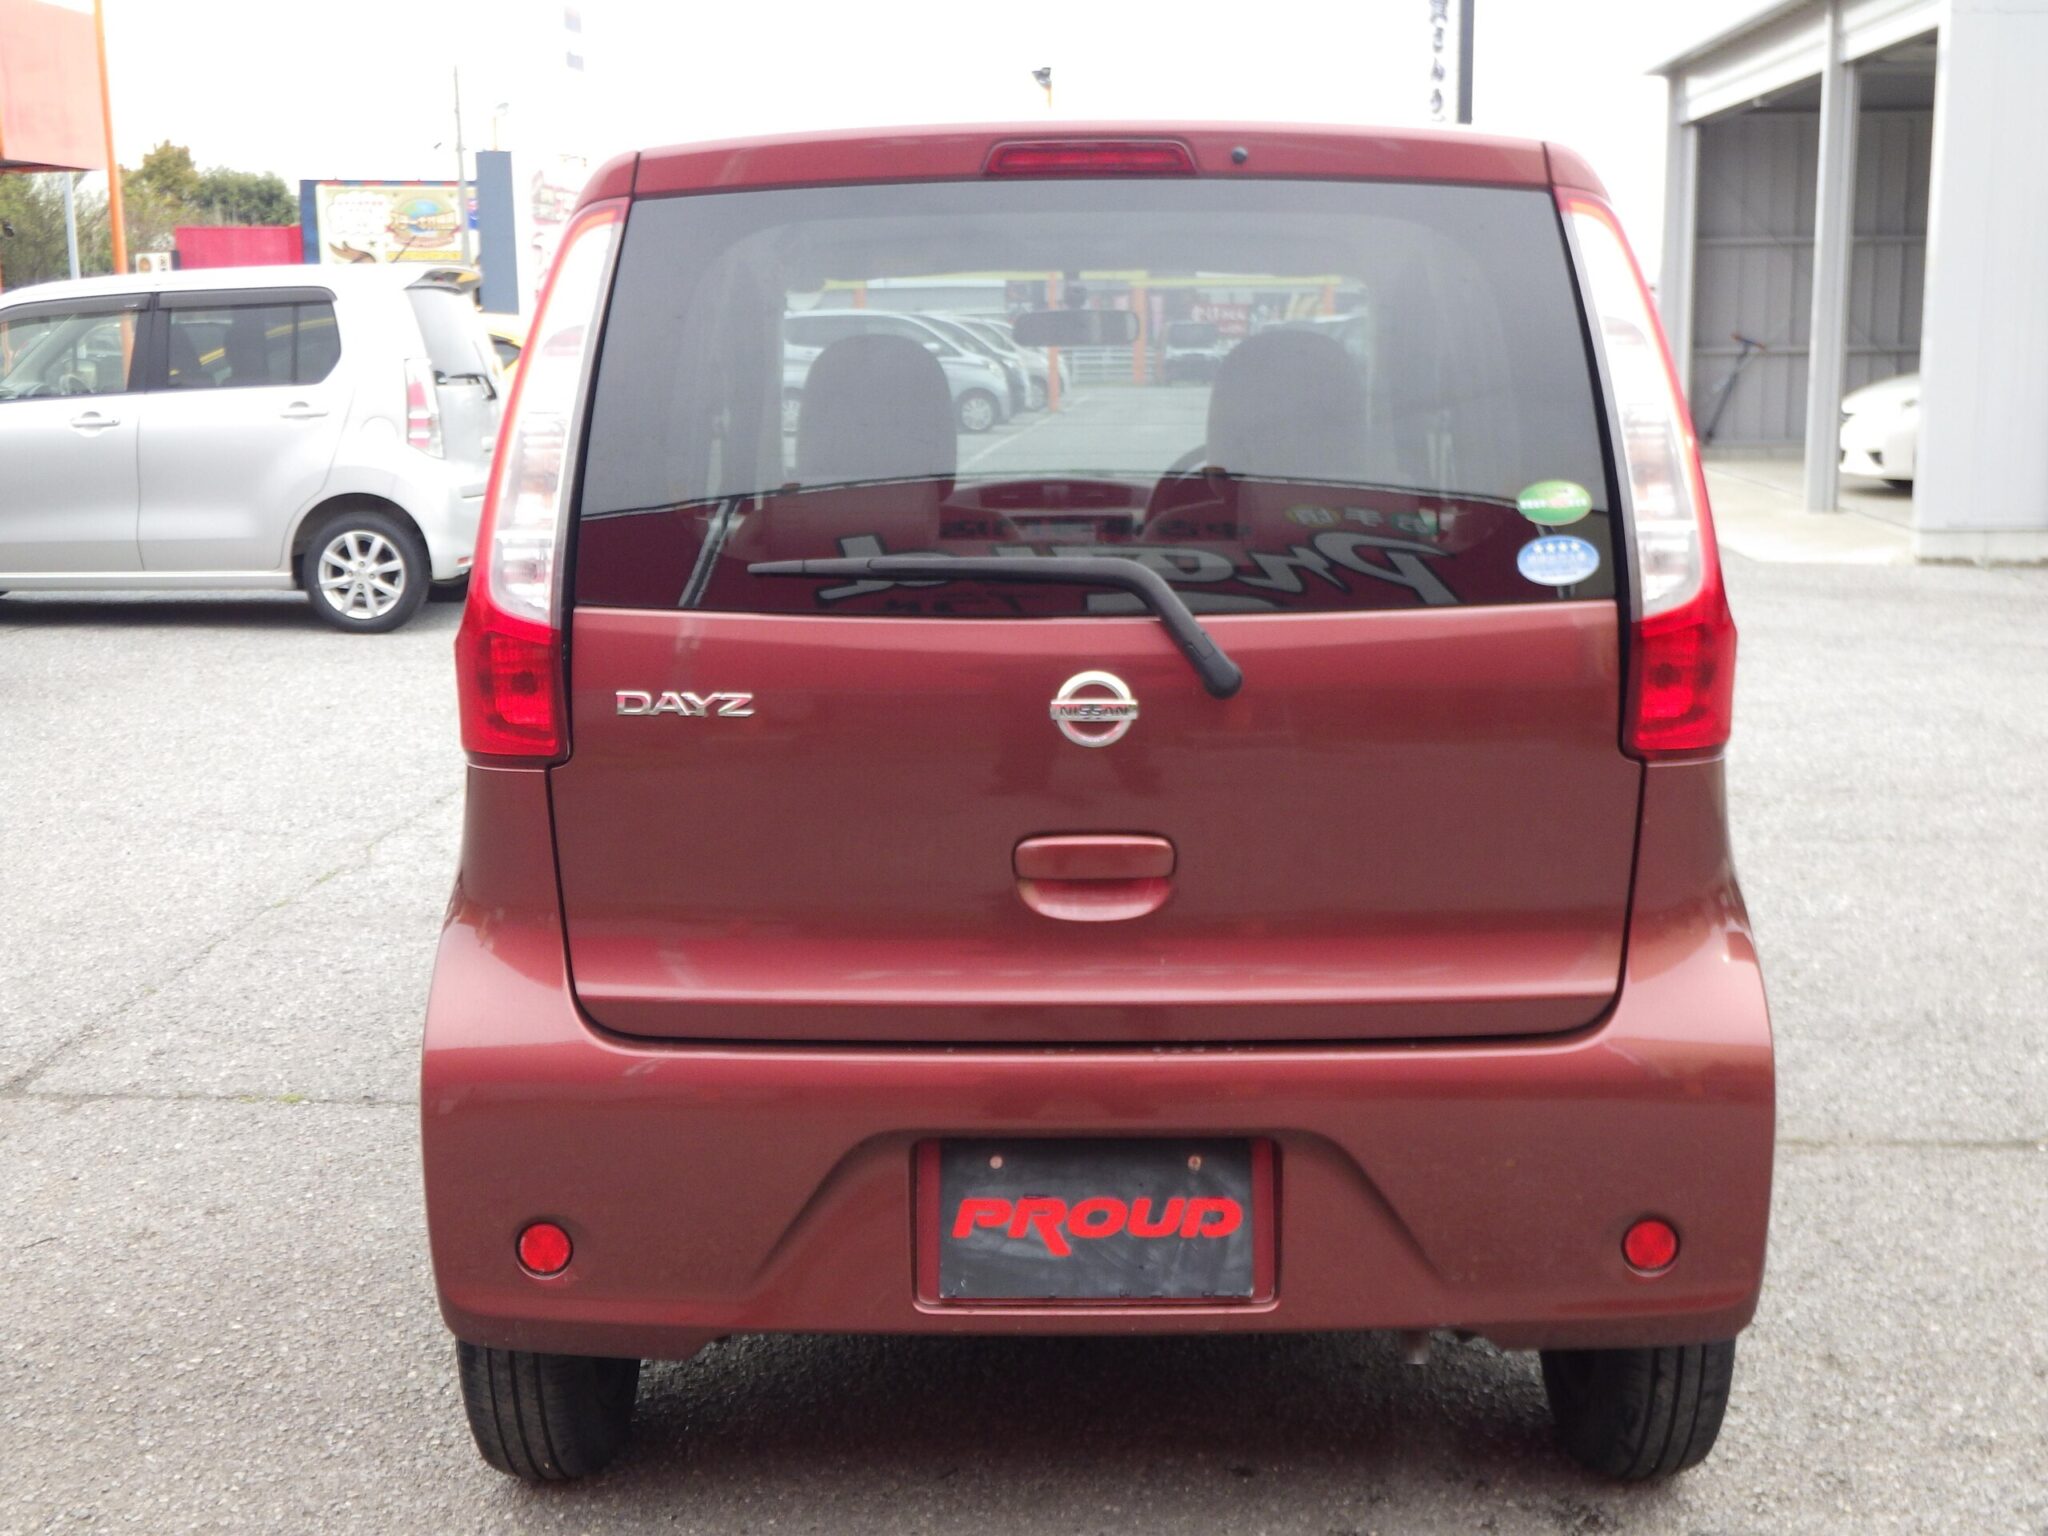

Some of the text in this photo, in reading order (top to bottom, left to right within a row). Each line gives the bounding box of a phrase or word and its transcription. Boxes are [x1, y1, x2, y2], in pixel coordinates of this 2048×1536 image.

[615, 690, 755, 717] DAYZ
[1059, 705, 1129, 718] NISSAN
[952, 1197, 1243, 1257] PROUD
